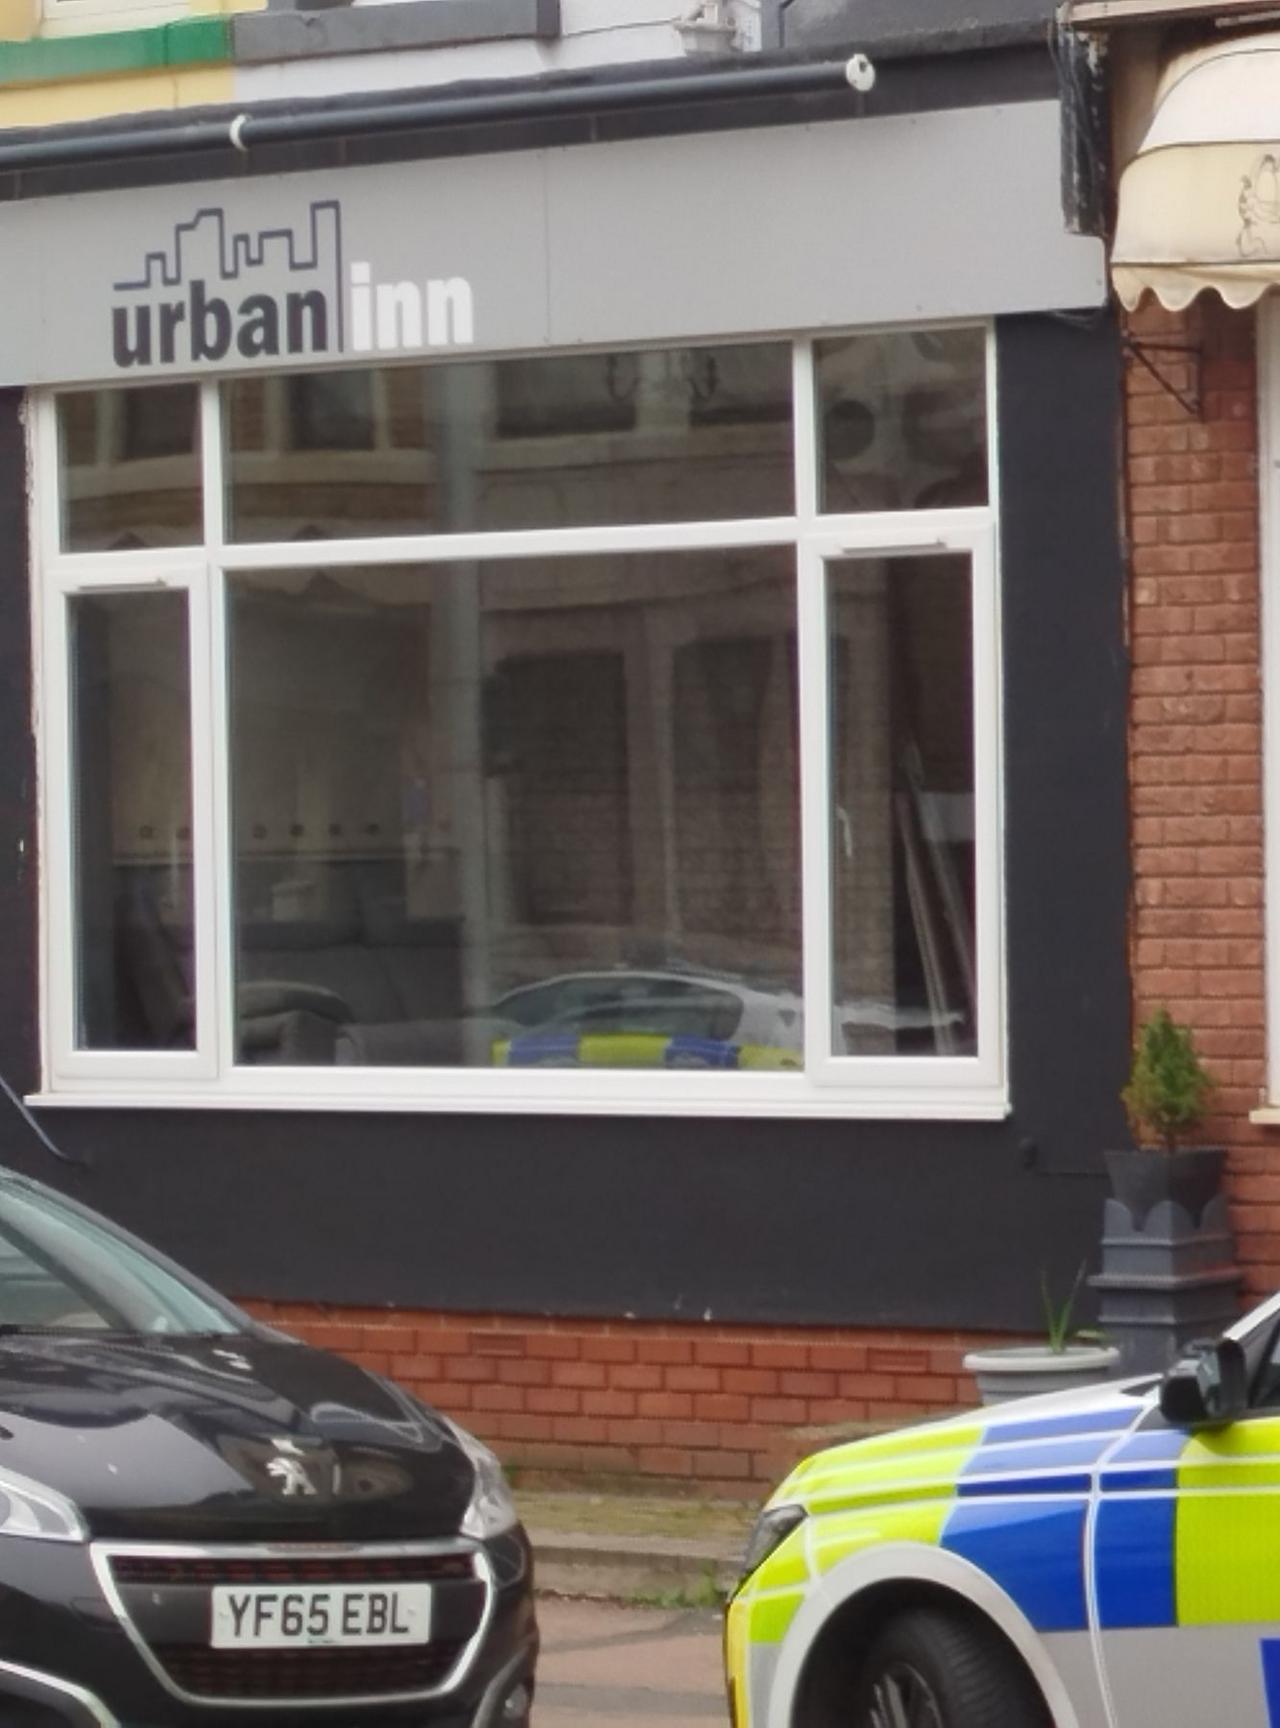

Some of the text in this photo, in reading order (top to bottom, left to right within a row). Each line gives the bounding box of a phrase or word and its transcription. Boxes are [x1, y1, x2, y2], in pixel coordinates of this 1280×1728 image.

[112, 261, 473, 367] urban inn
[228, 1592, 409, 1638] YF65 EBL
